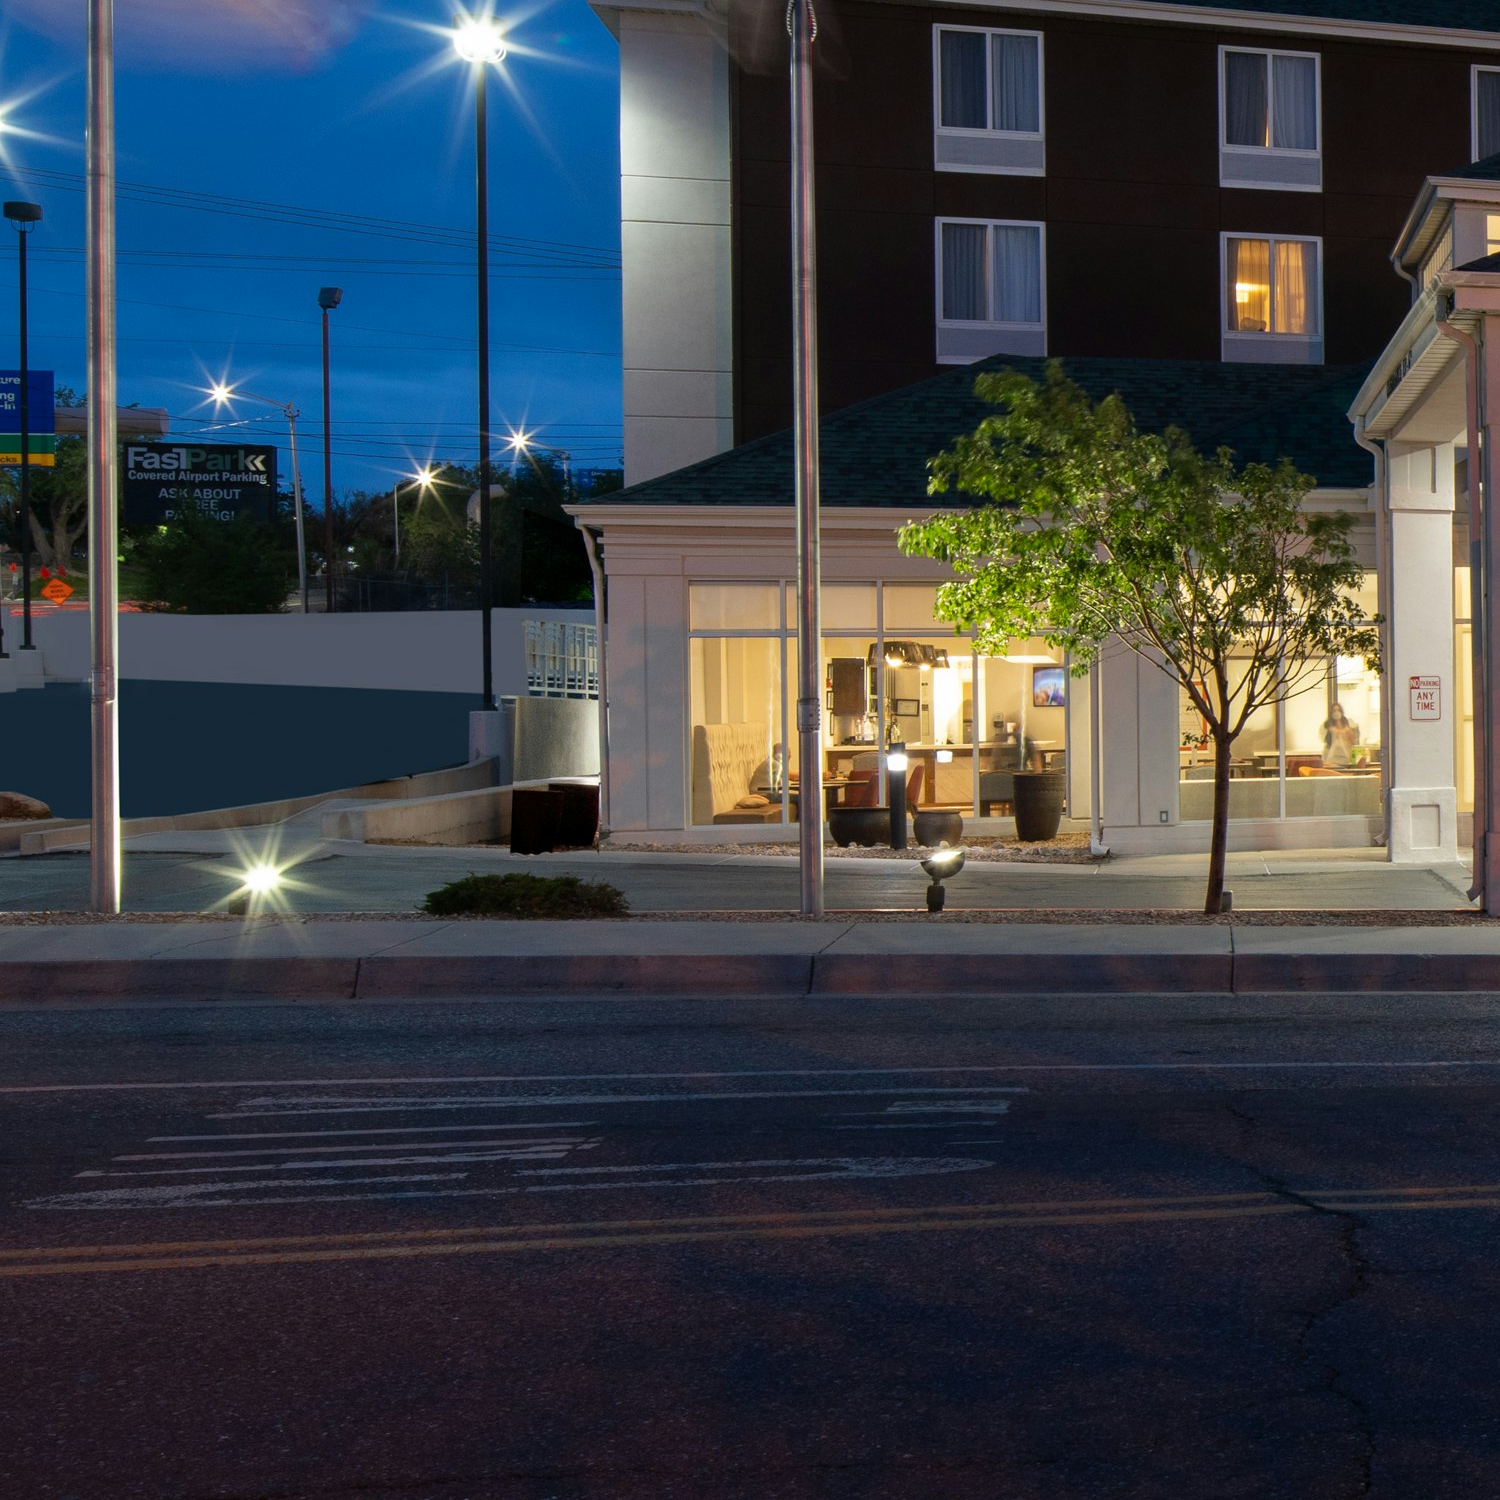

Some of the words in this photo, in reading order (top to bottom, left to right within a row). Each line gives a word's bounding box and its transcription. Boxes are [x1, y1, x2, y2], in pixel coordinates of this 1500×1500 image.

[128, 470, 176, 480] Covered
[178, 471, 219, 483] Airport
[222, 472, 267, 484] Parking
[158, 488, 188, 498] ASK
[193, 489, 241, 500] ABOUT
[1410, 678, 1419, 688] NO
[1416, 691, 1435, 700] ANY
[1416, 702, 1435, 711] TIME
